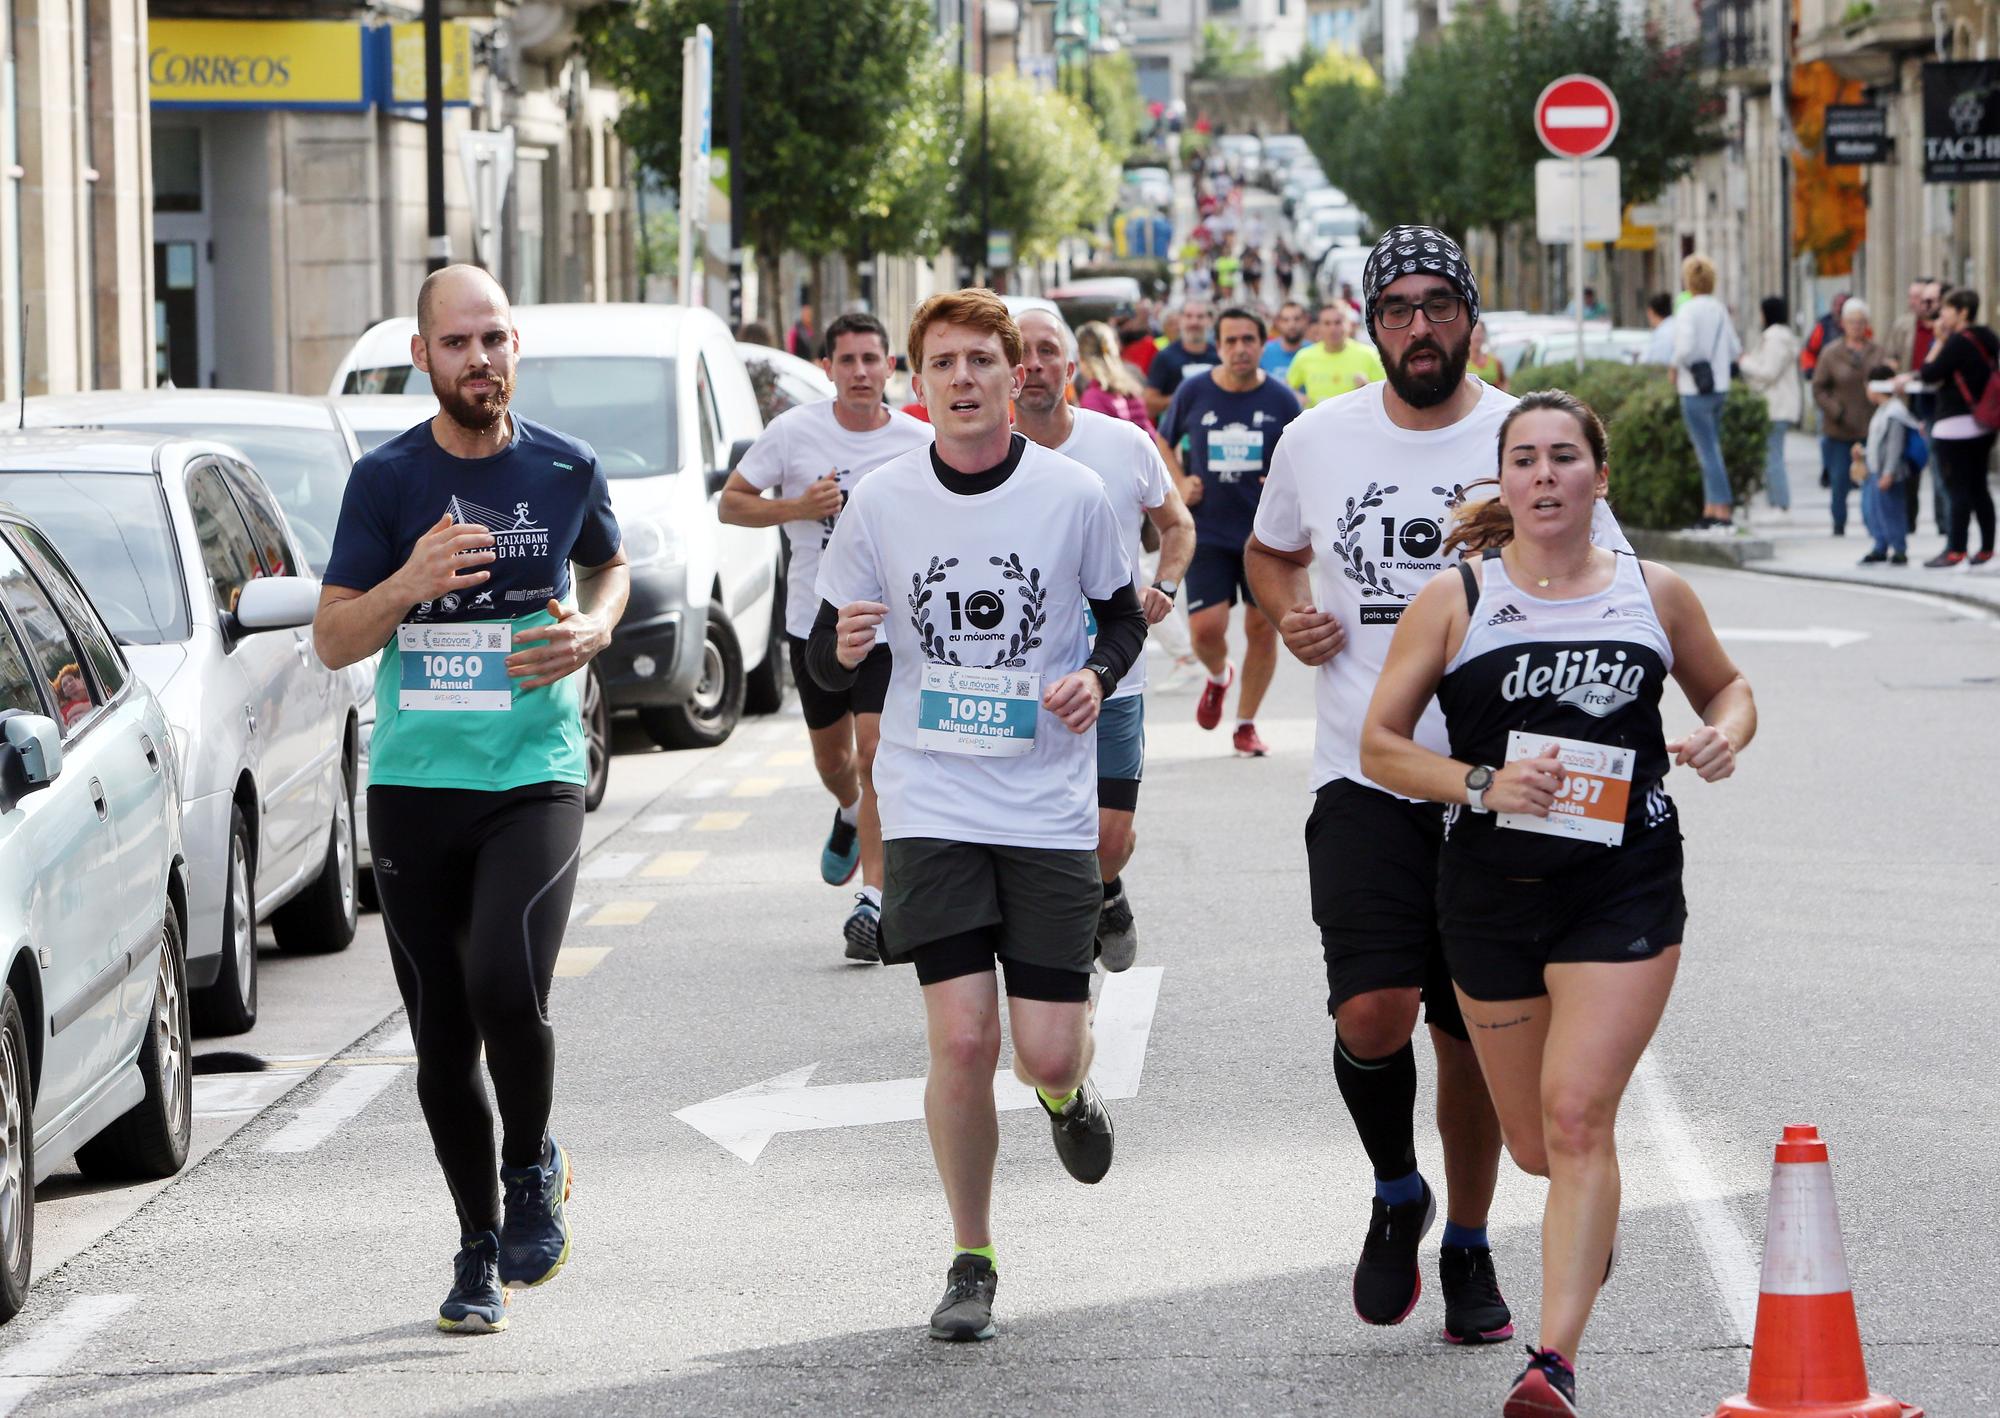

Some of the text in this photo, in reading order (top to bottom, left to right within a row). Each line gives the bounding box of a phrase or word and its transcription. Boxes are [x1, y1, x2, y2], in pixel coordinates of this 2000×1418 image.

[149, 47, 290, 87] CORREOS
[497, 534, 549, 546] CAIXABANK
[533, 544, 548, 557] 22
[1363, 612, 1382, 620] pola
[1488, 614, 1528, 626] adidas
[423, 655, 482, 677] 1060
[1501, 649, 1645, 702] delikia
[430, 679, 473, 690] Manuel
[948, 697, 1007, 724] 1095
[938, 719, 1014, 737] Miguel Angel
